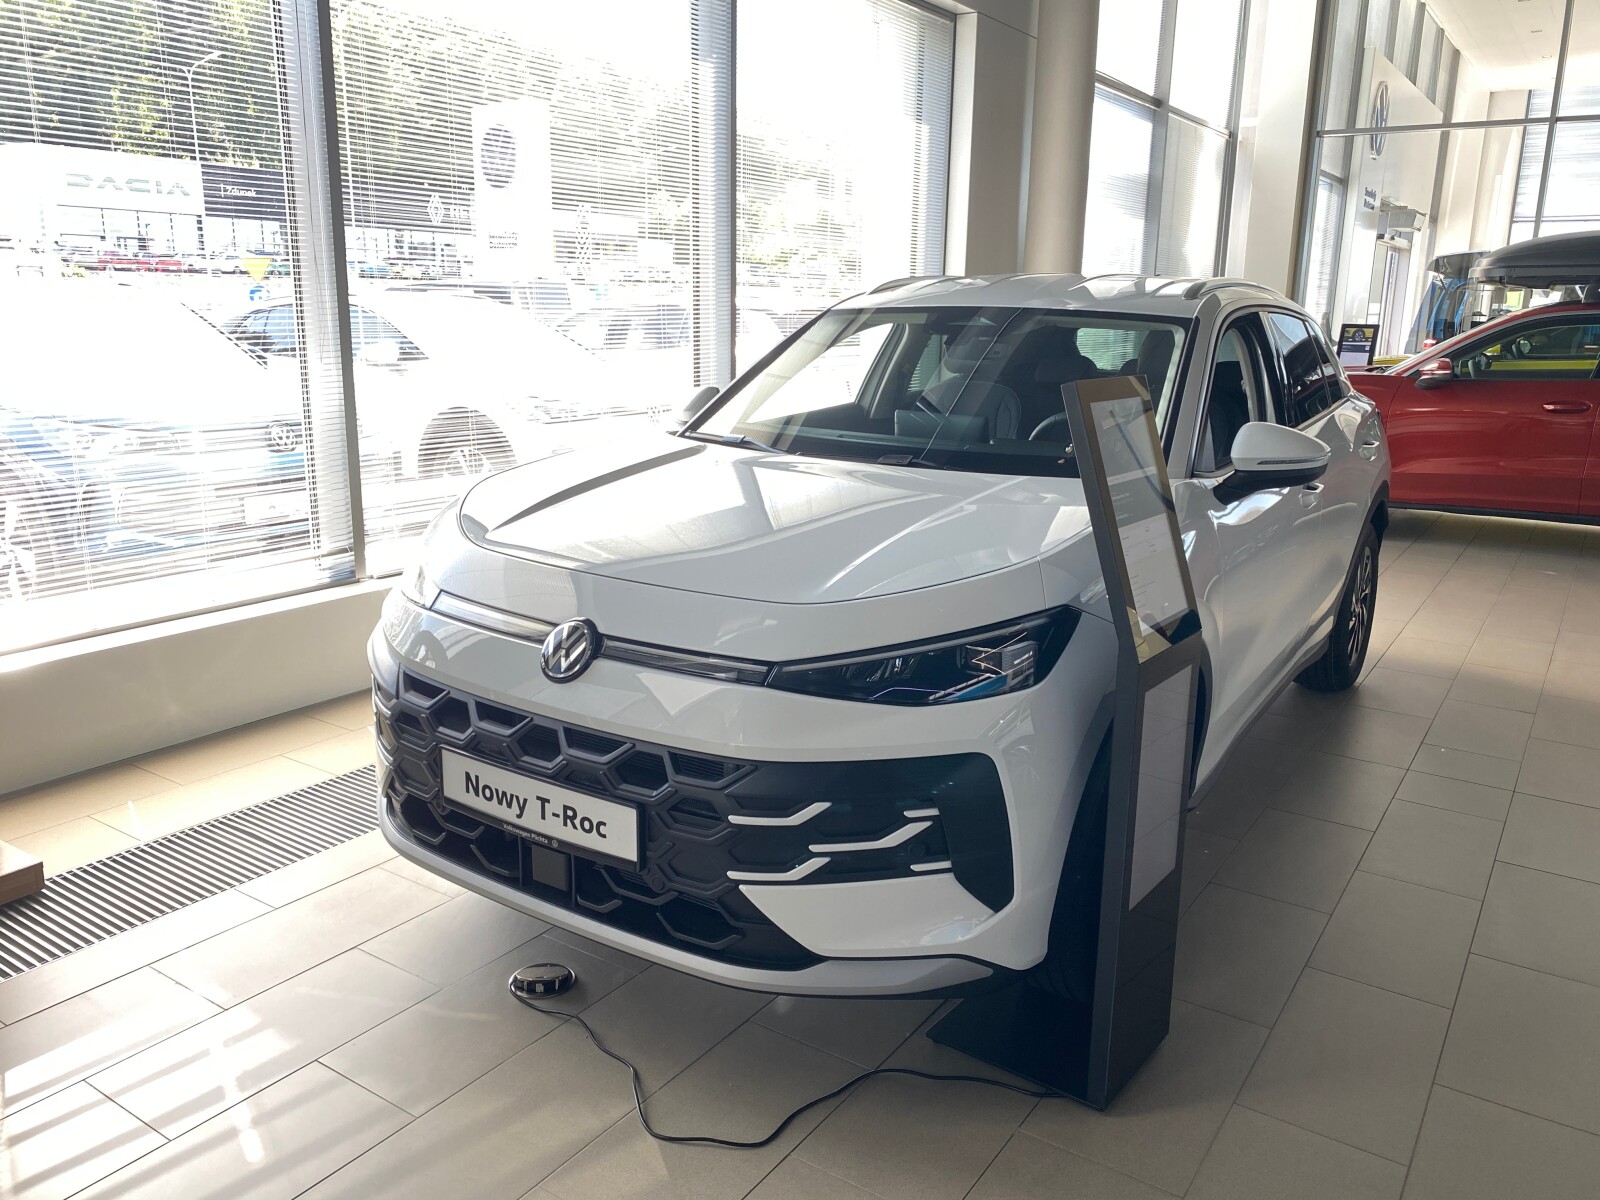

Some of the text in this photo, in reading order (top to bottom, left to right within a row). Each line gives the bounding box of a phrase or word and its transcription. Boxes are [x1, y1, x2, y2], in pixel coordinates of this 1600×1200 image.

[66, 173, 190, 196] DACIA
[465, 770, 607, 838] Nowy T-Roc
[503, 823, 531, 838] Volkswagen
